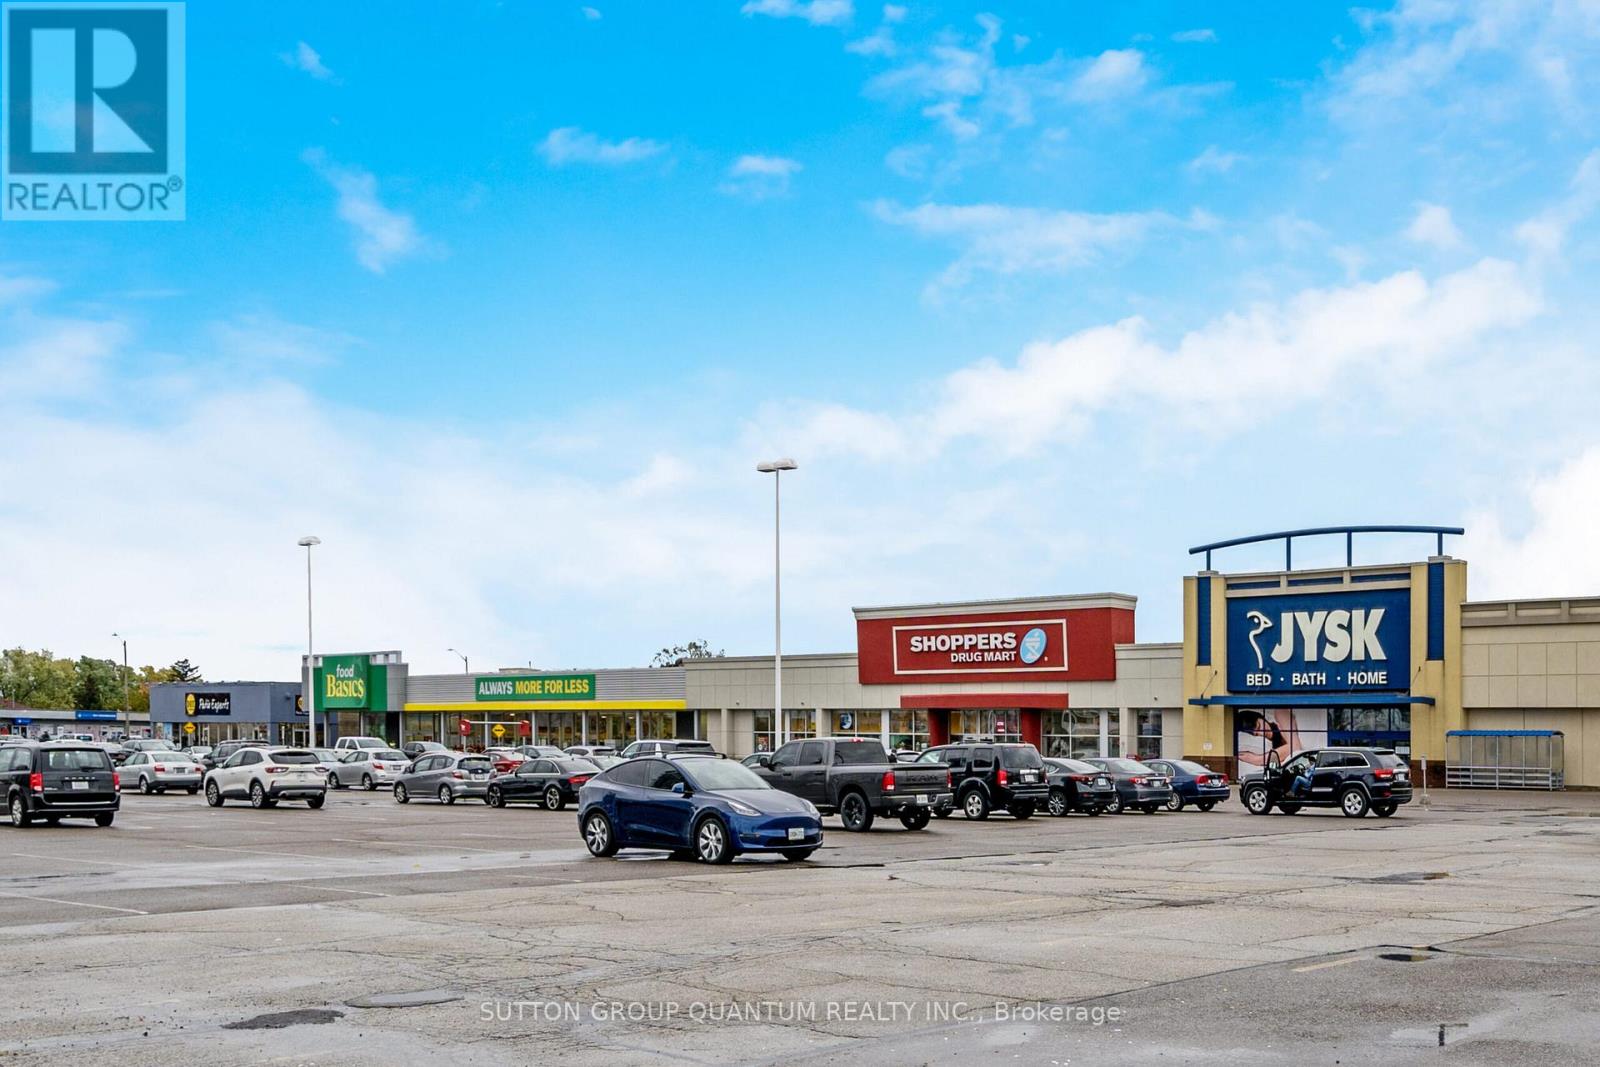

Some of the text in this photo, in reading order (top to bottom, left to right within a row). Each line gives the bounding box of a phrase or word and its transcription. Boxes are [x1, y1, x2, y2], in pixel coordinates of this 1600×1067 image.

[910, 632, 1017, 652] SHOPPERS
[1270, 608, 1387, 663] JYSK
[951, 651, 1016, 663] DRUG MART
[336, 664, 354, 677] food
[1246, 671, 1387, 686] BED BATH HOME
[479, 679, 589, 695] ALWAYS MORE FOR LESS
